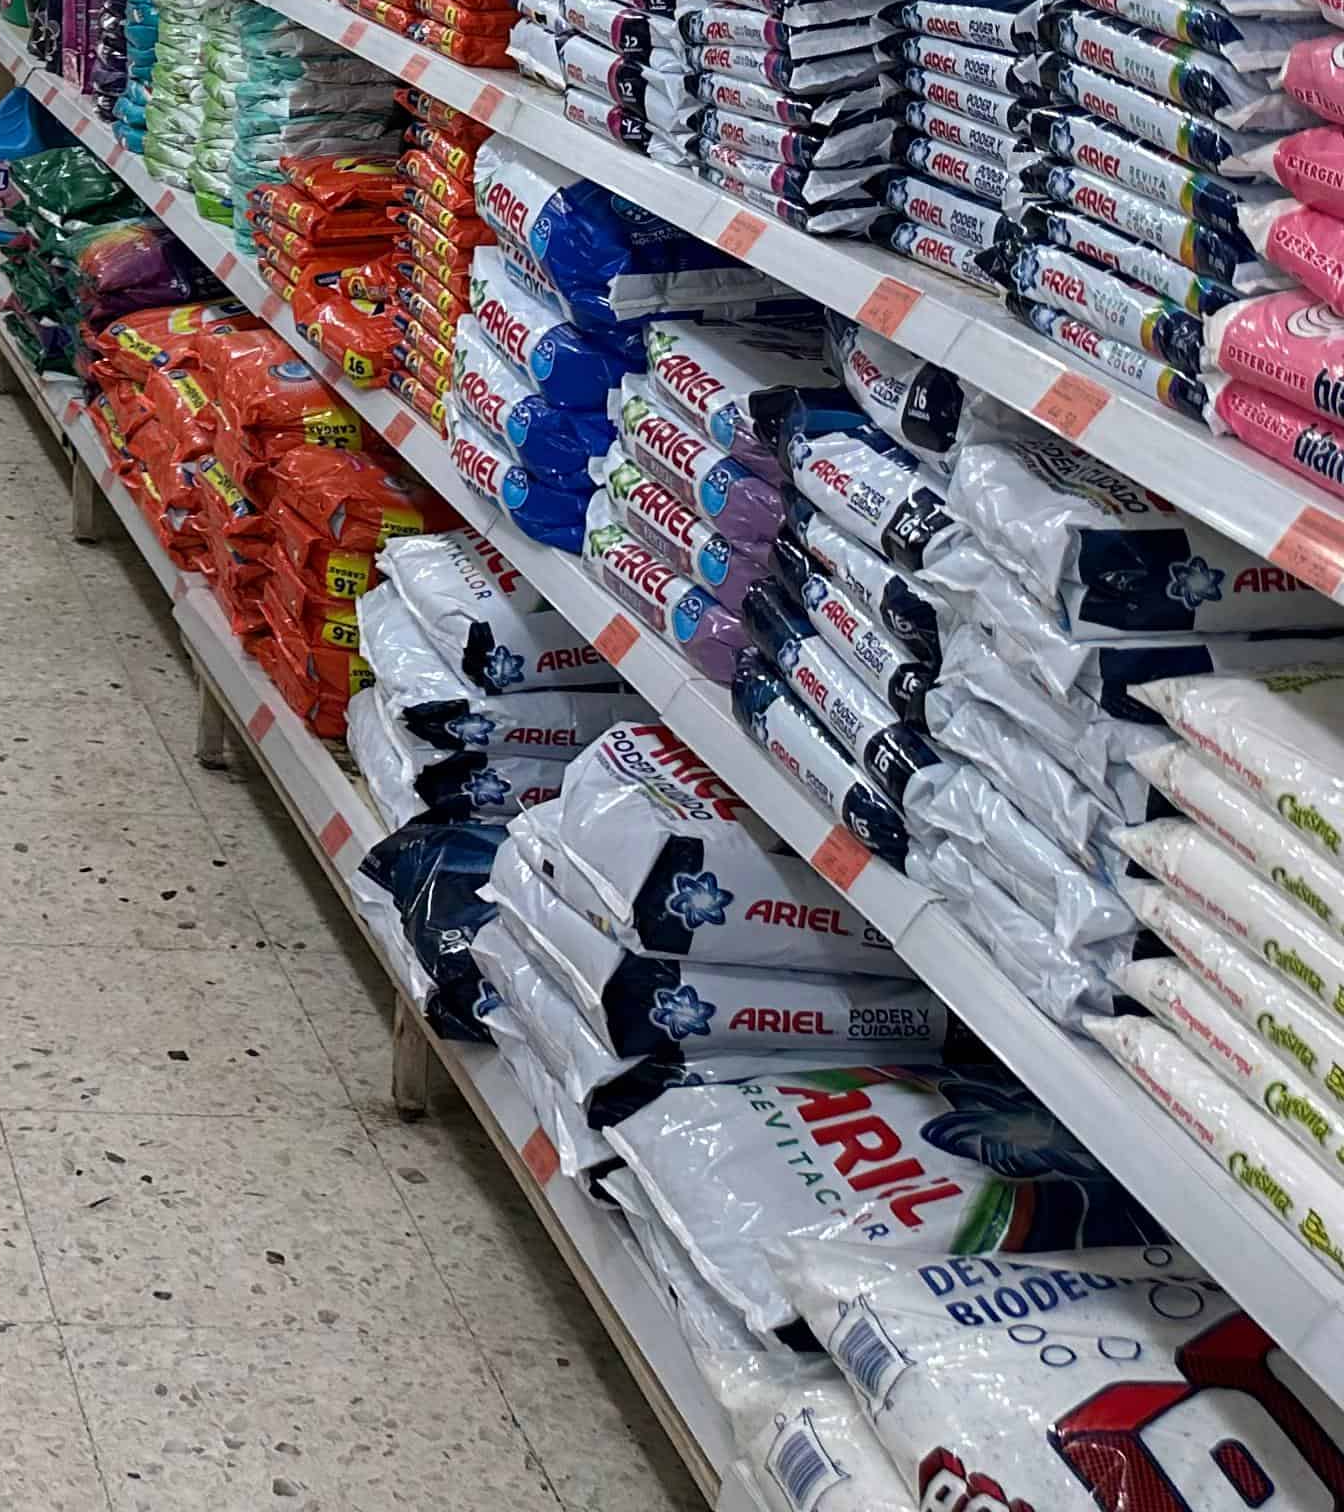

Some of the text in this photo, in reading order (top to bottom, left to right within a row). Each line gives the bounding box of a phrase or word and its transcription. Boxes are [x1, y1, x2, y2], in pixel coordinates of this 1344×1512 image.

[964, 58, 990, 76] PODER
[1080, 39, 1121, 74] ARIEL
[717, 87, 744, 108] ARIEL
[928, 82, 963, 111] ARIEL
[966, 93, 992, 112] PODER
[928, 118, 995, 148] ARIEL PODER
[932, 152, 970, 185] ARIEL
[1077, 144, 1123, 181] ARIEL
[1129, 166, 1166, 189] REVITA
[486, 182, 530, 241] ARIEL
[909, 198, 946, 228] ARIEL
[951, 210, 976, 230] PODER
[1075, 186, 1119, 225] ARIEL
[916, 237, 958, 267] ARIEL
[478, 300, 532, 365] ARIEL
[348, 357, 365, 374] 16
[1107, 357, 1143, 380] COLOR
[1226, 345, 1309, 391] DETERGENTE
[655, 354, 724, 413] ARIEL
[913, 387, 927, 409] 16
[459, 370, 506, 435] ARIEL
[637, 412, 702, 478] ARIEL
[450, 437, 501, 496] ARIEL
[810, 458, 853, 497] ARIEL
[629, 481, 697, 547] ARIEL
[604, 542, 681, 606] ARIEL
[821, 600, 859, 643] ARIEL
[796, 667, 830, 712] ARIEL
[504, 728, 585, 746] ARIEL
[611, 730, 657, 774] PODER
[745, 900, 854, 936] ARIEL
[729, 1007, 834, 1035] ARIEL
[848, 1025, 930, 1037] CUIDADO
[849, 1009, 929, 1024] PODER Y
